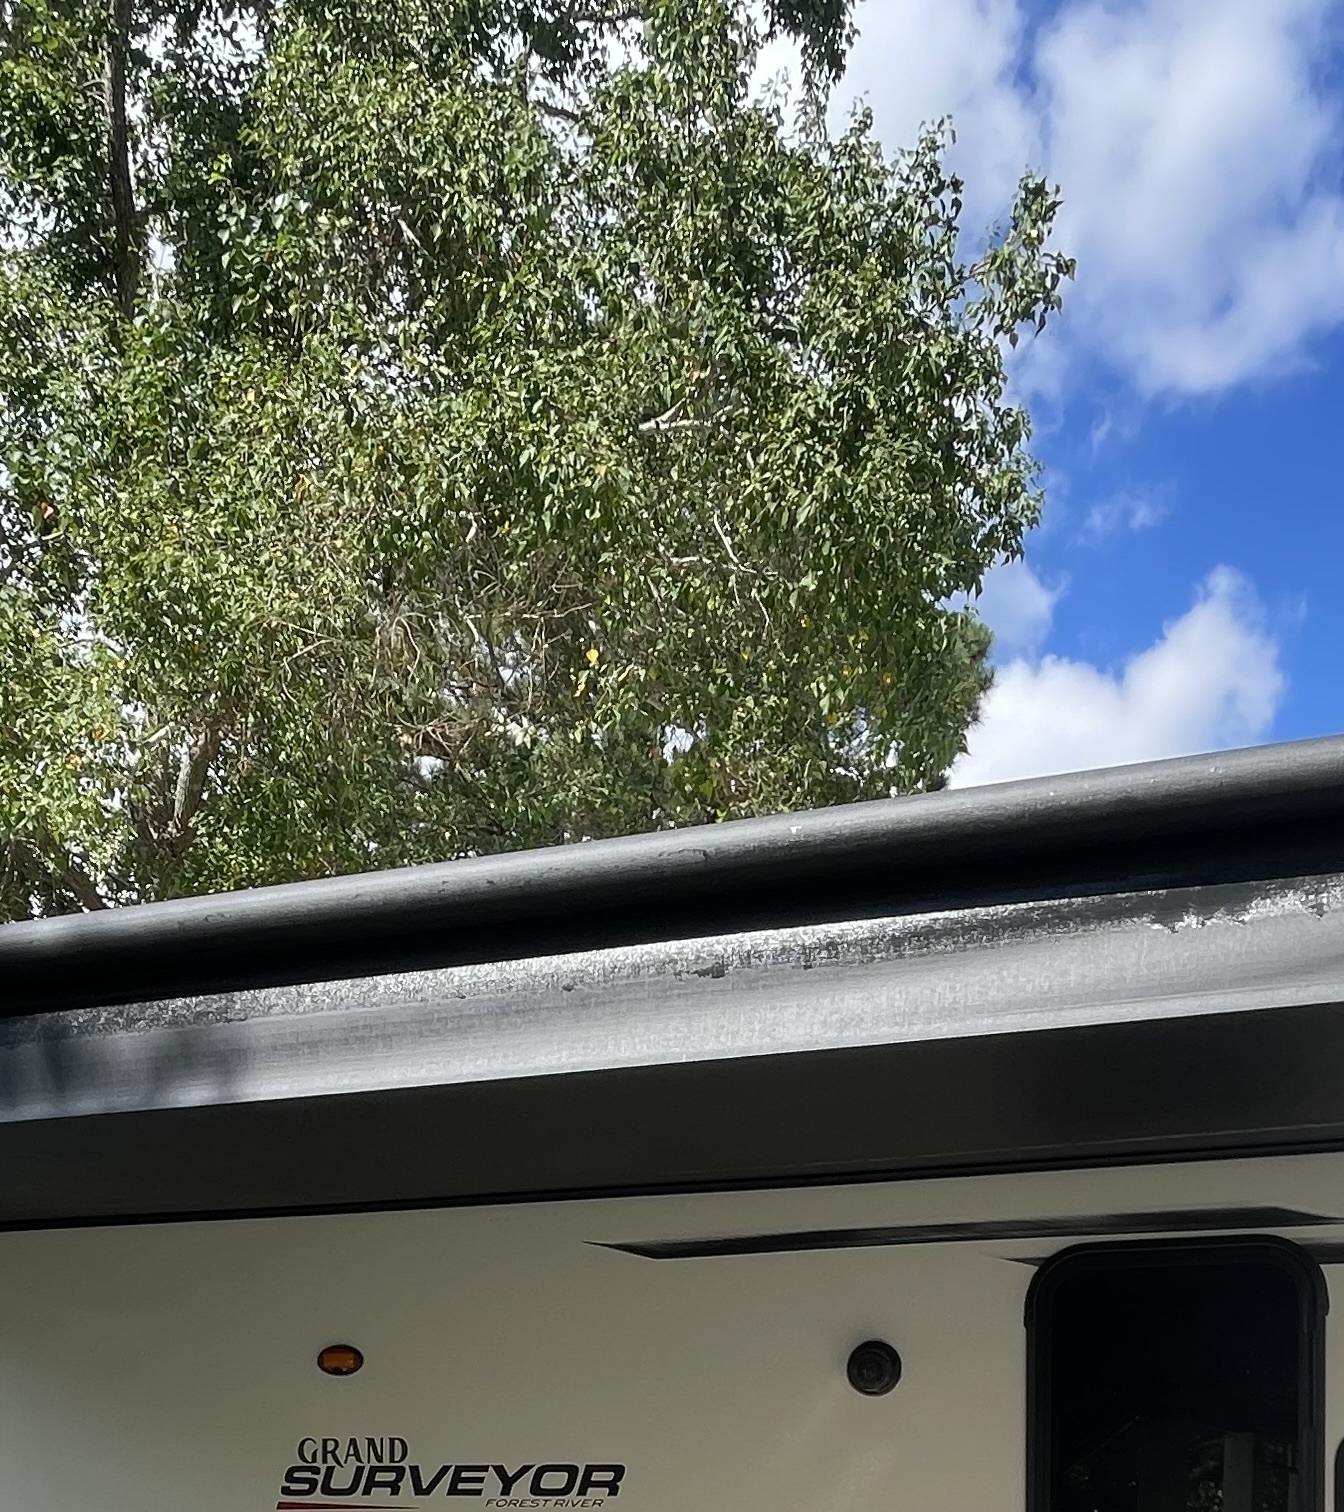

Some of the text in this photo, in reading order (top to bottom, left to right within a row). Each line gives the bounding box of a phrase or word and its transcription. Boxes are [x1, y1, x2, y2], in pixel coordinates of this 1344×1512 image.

[297, 1436, 409, 1467] GRAND
[280, 1463, 627, 1497] SURVEYOR
[485, 1498, 605, 1508] FOREST RIVER
